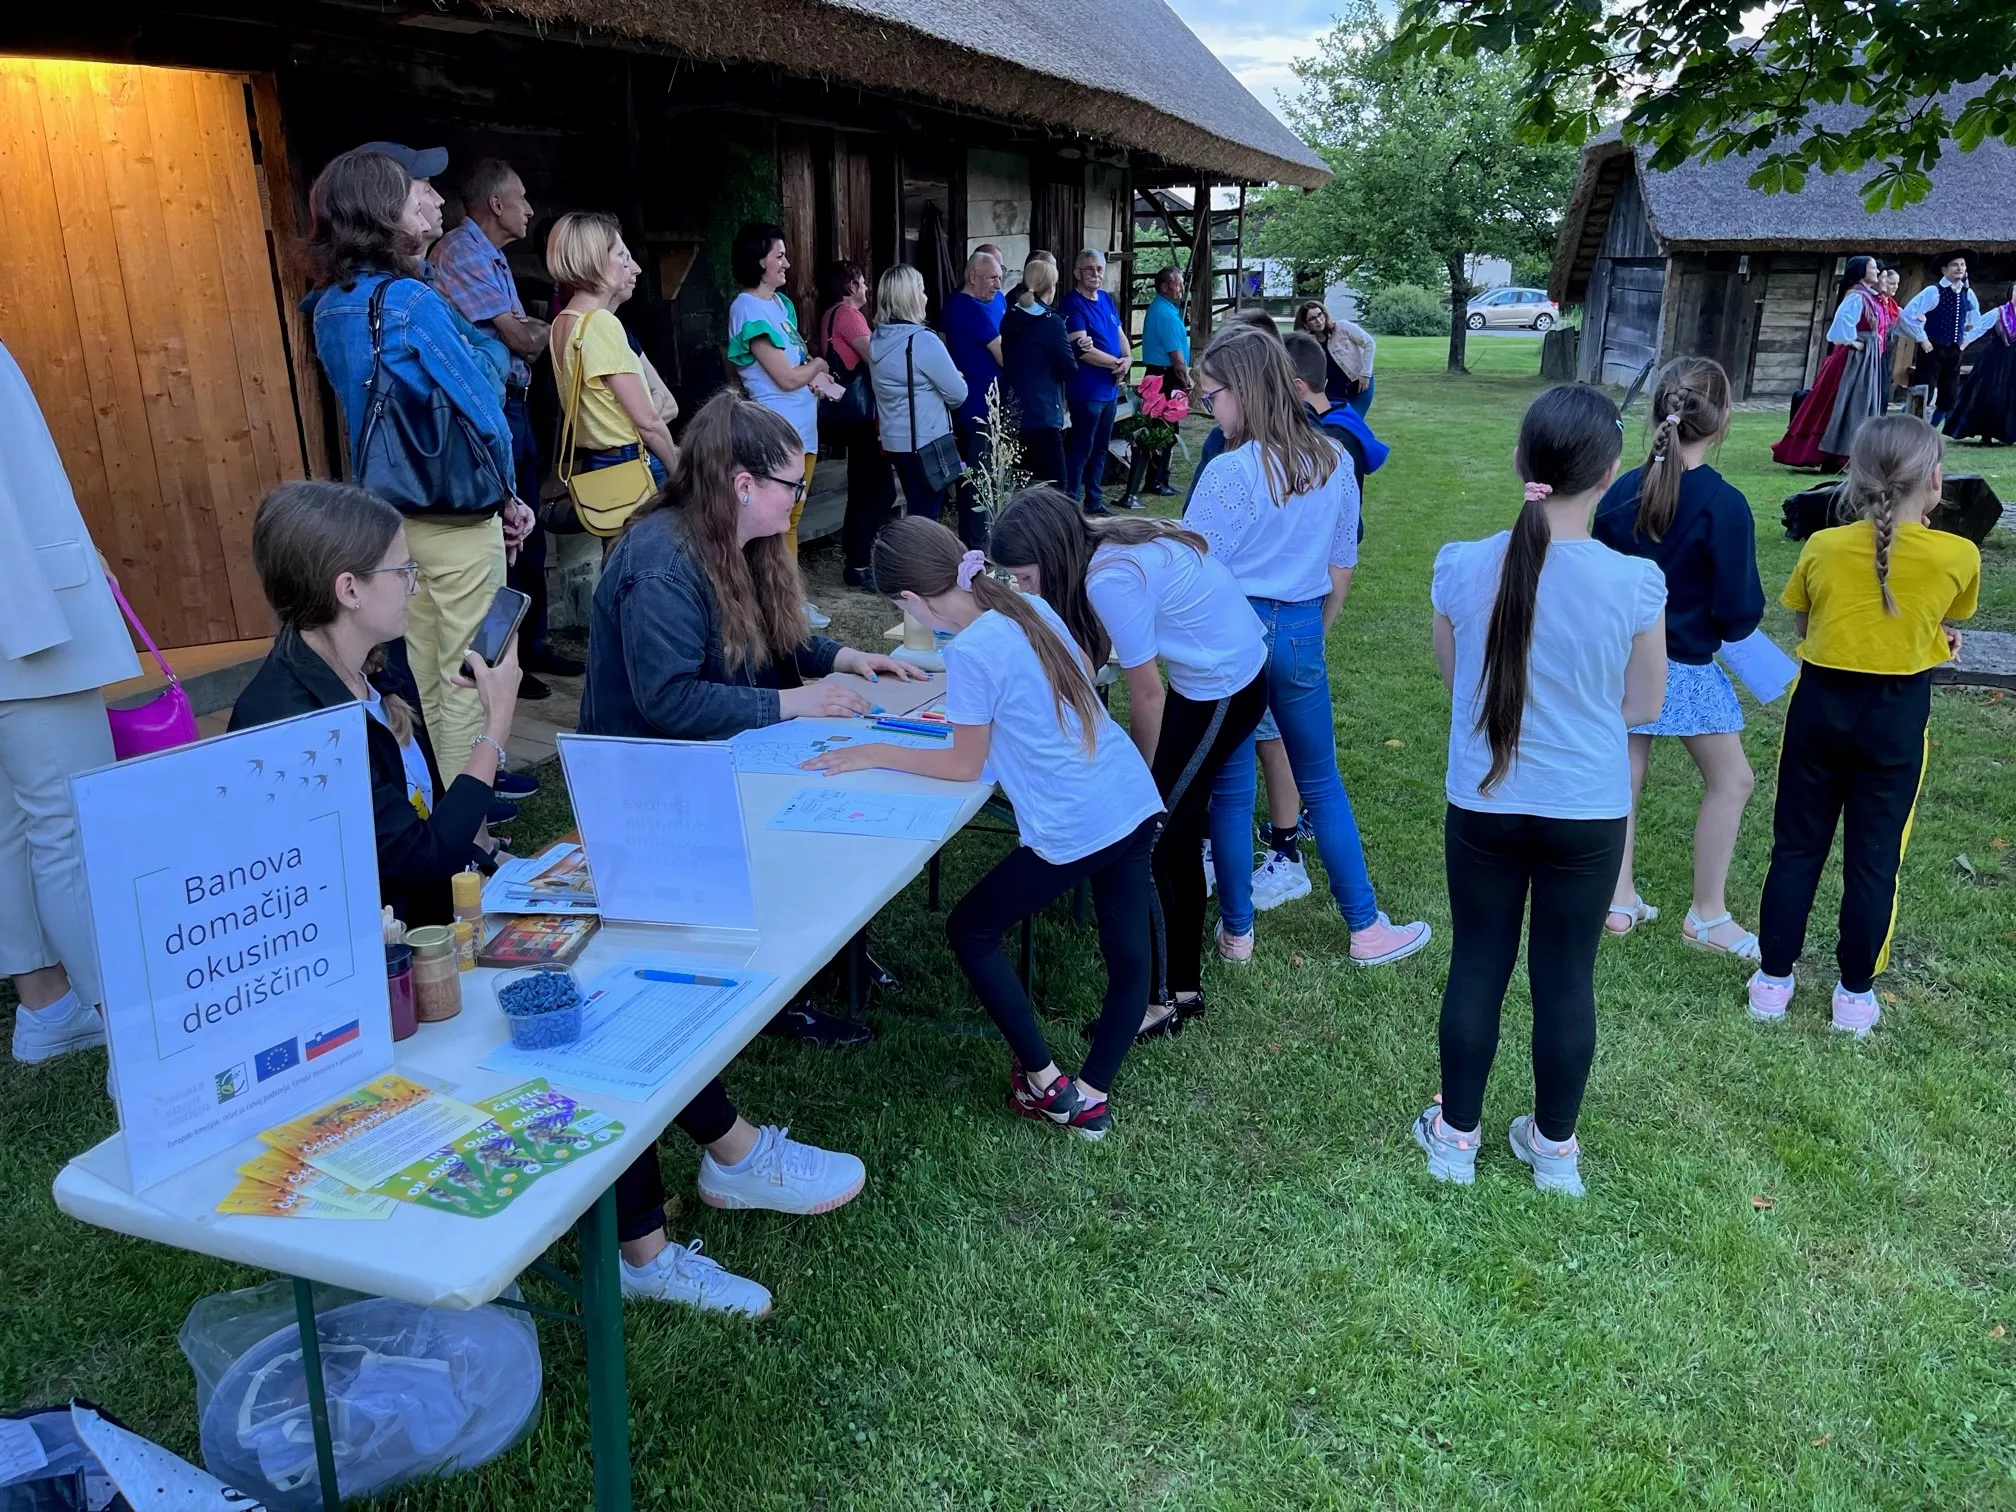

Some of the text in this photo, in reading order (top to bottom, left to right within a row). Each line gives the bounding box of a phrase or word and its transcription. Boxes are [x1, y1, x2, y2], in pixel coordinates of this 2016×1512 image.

[184, 846, 302, 905] Banova
[164, 884, 309, 956] domačija
[185, 921, 319, 990] okusimo
[182, 956, 330, 1035] dediščino
[491, 1087, 544, 1112] ČEBELE
[511, 1101, 567, 1128] OKOLJE
